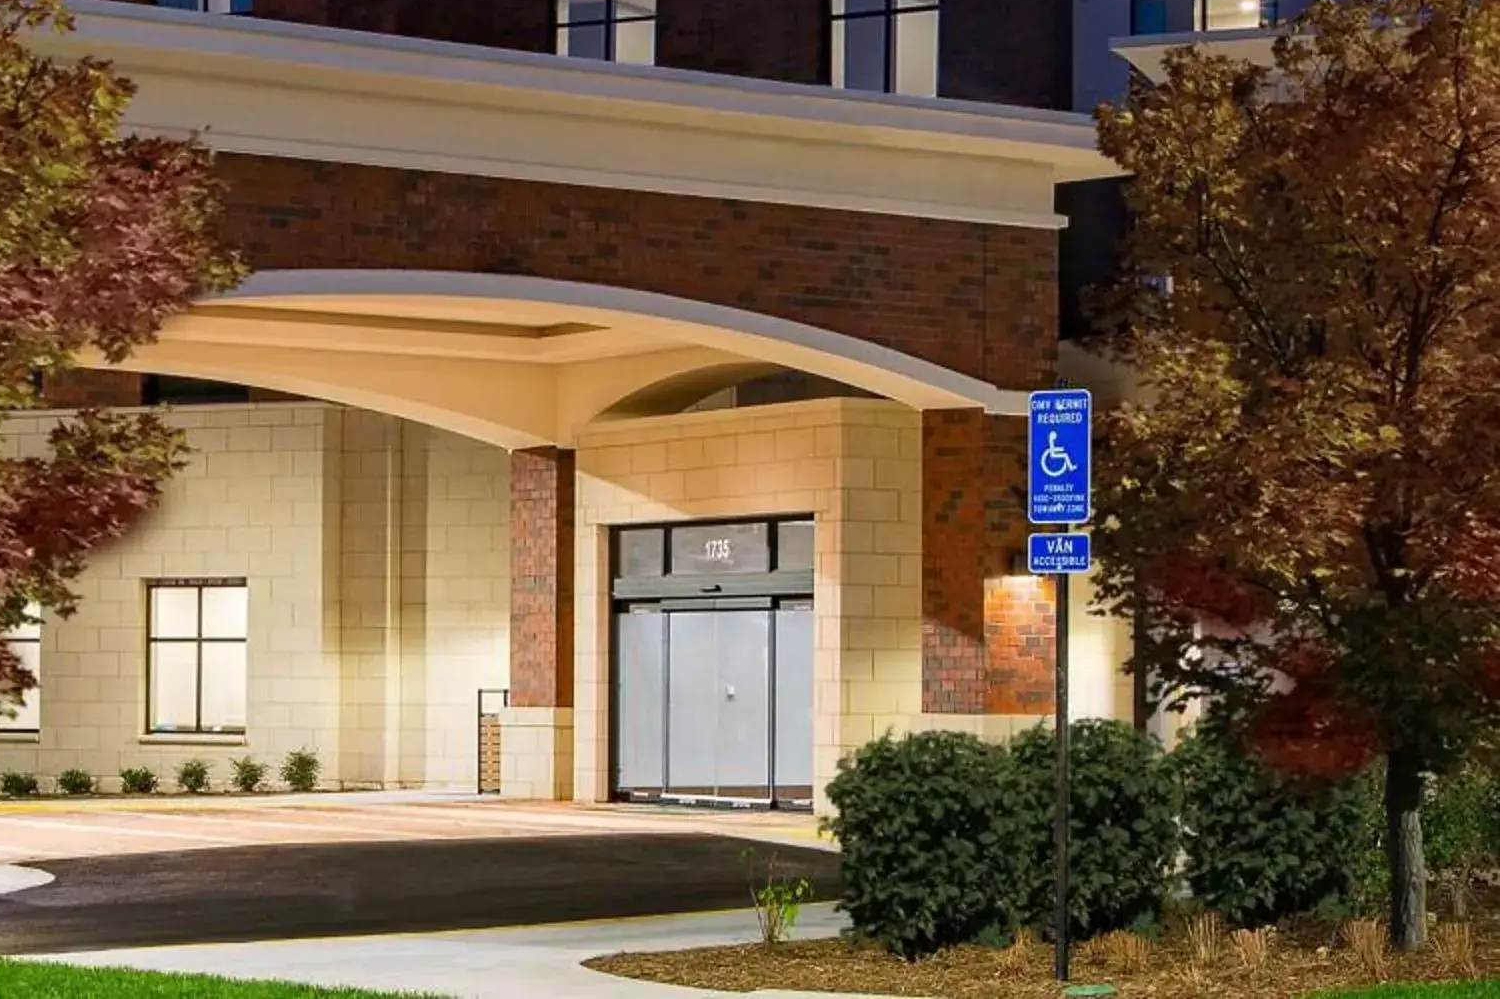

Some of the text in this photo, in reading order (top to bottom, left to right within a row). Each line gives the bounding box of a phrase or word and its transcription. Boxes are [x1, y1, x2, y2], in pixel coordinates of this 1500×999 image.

[1037, 412, 1082, 424] REQUIRED
[705, 539, 731, 559] 1735
[1046, 540, 1073, 553] VAN
[1033, 556, 1086, 566] ACCESSIBLE
